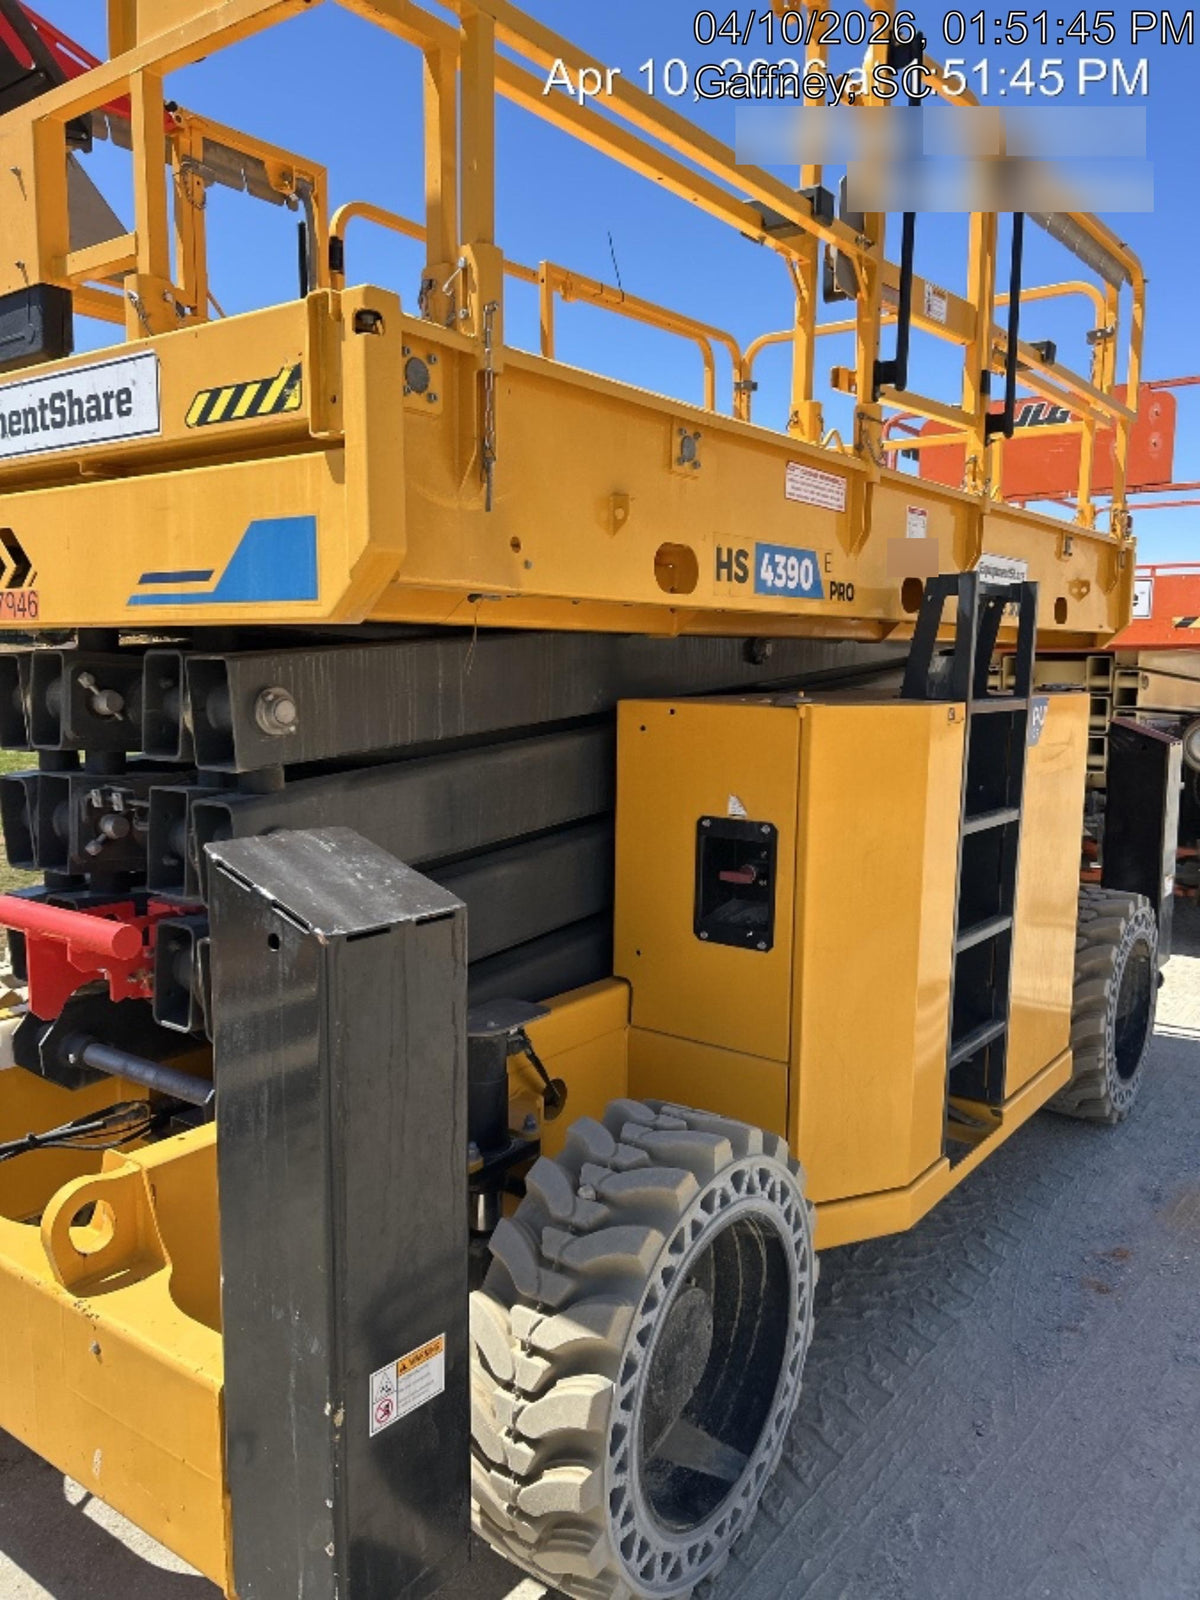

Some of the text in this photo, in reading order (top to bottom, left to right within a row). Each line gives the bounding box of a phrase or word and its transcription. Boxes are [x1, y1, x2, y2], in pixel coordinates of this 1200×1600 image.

[715, 543, 855, 602] HS 4390 E PRO
